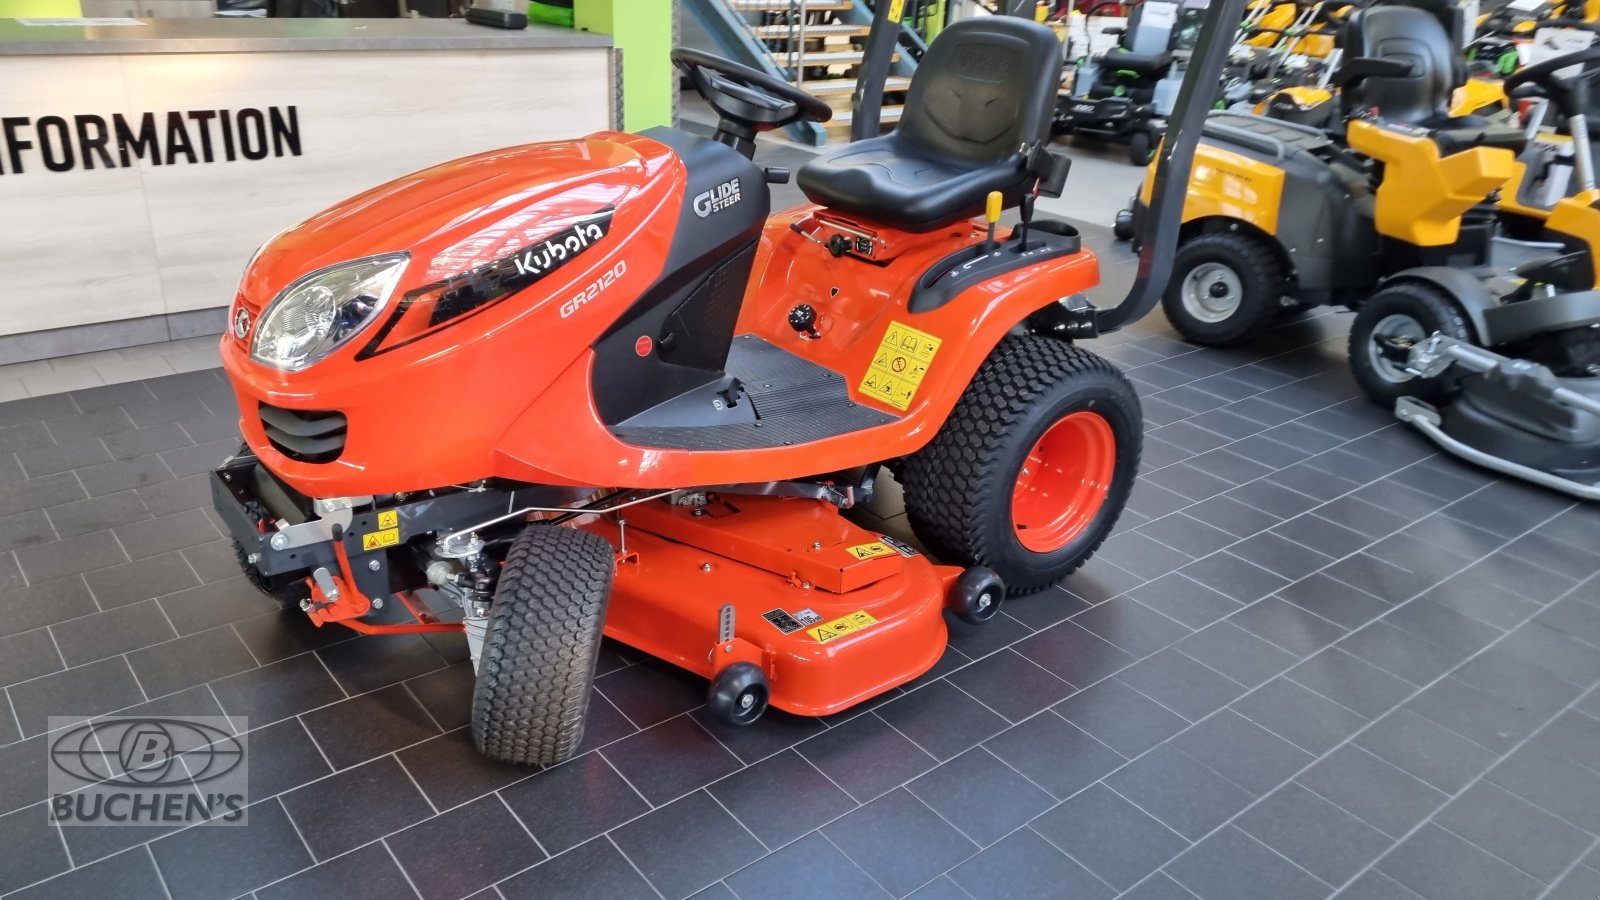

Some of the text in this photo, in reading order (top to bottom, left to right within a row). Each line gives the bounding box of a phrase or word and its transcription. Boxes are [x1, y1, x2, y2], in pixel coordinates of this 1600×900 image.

[0, 106, 303, 175] FORMATION
[693, 177, 740, 218] GLIDE
[713, 192, 741, 213] STEER
[514, 224, 603, 275] Kubota
[560, 260, 628, 318] GR2120
